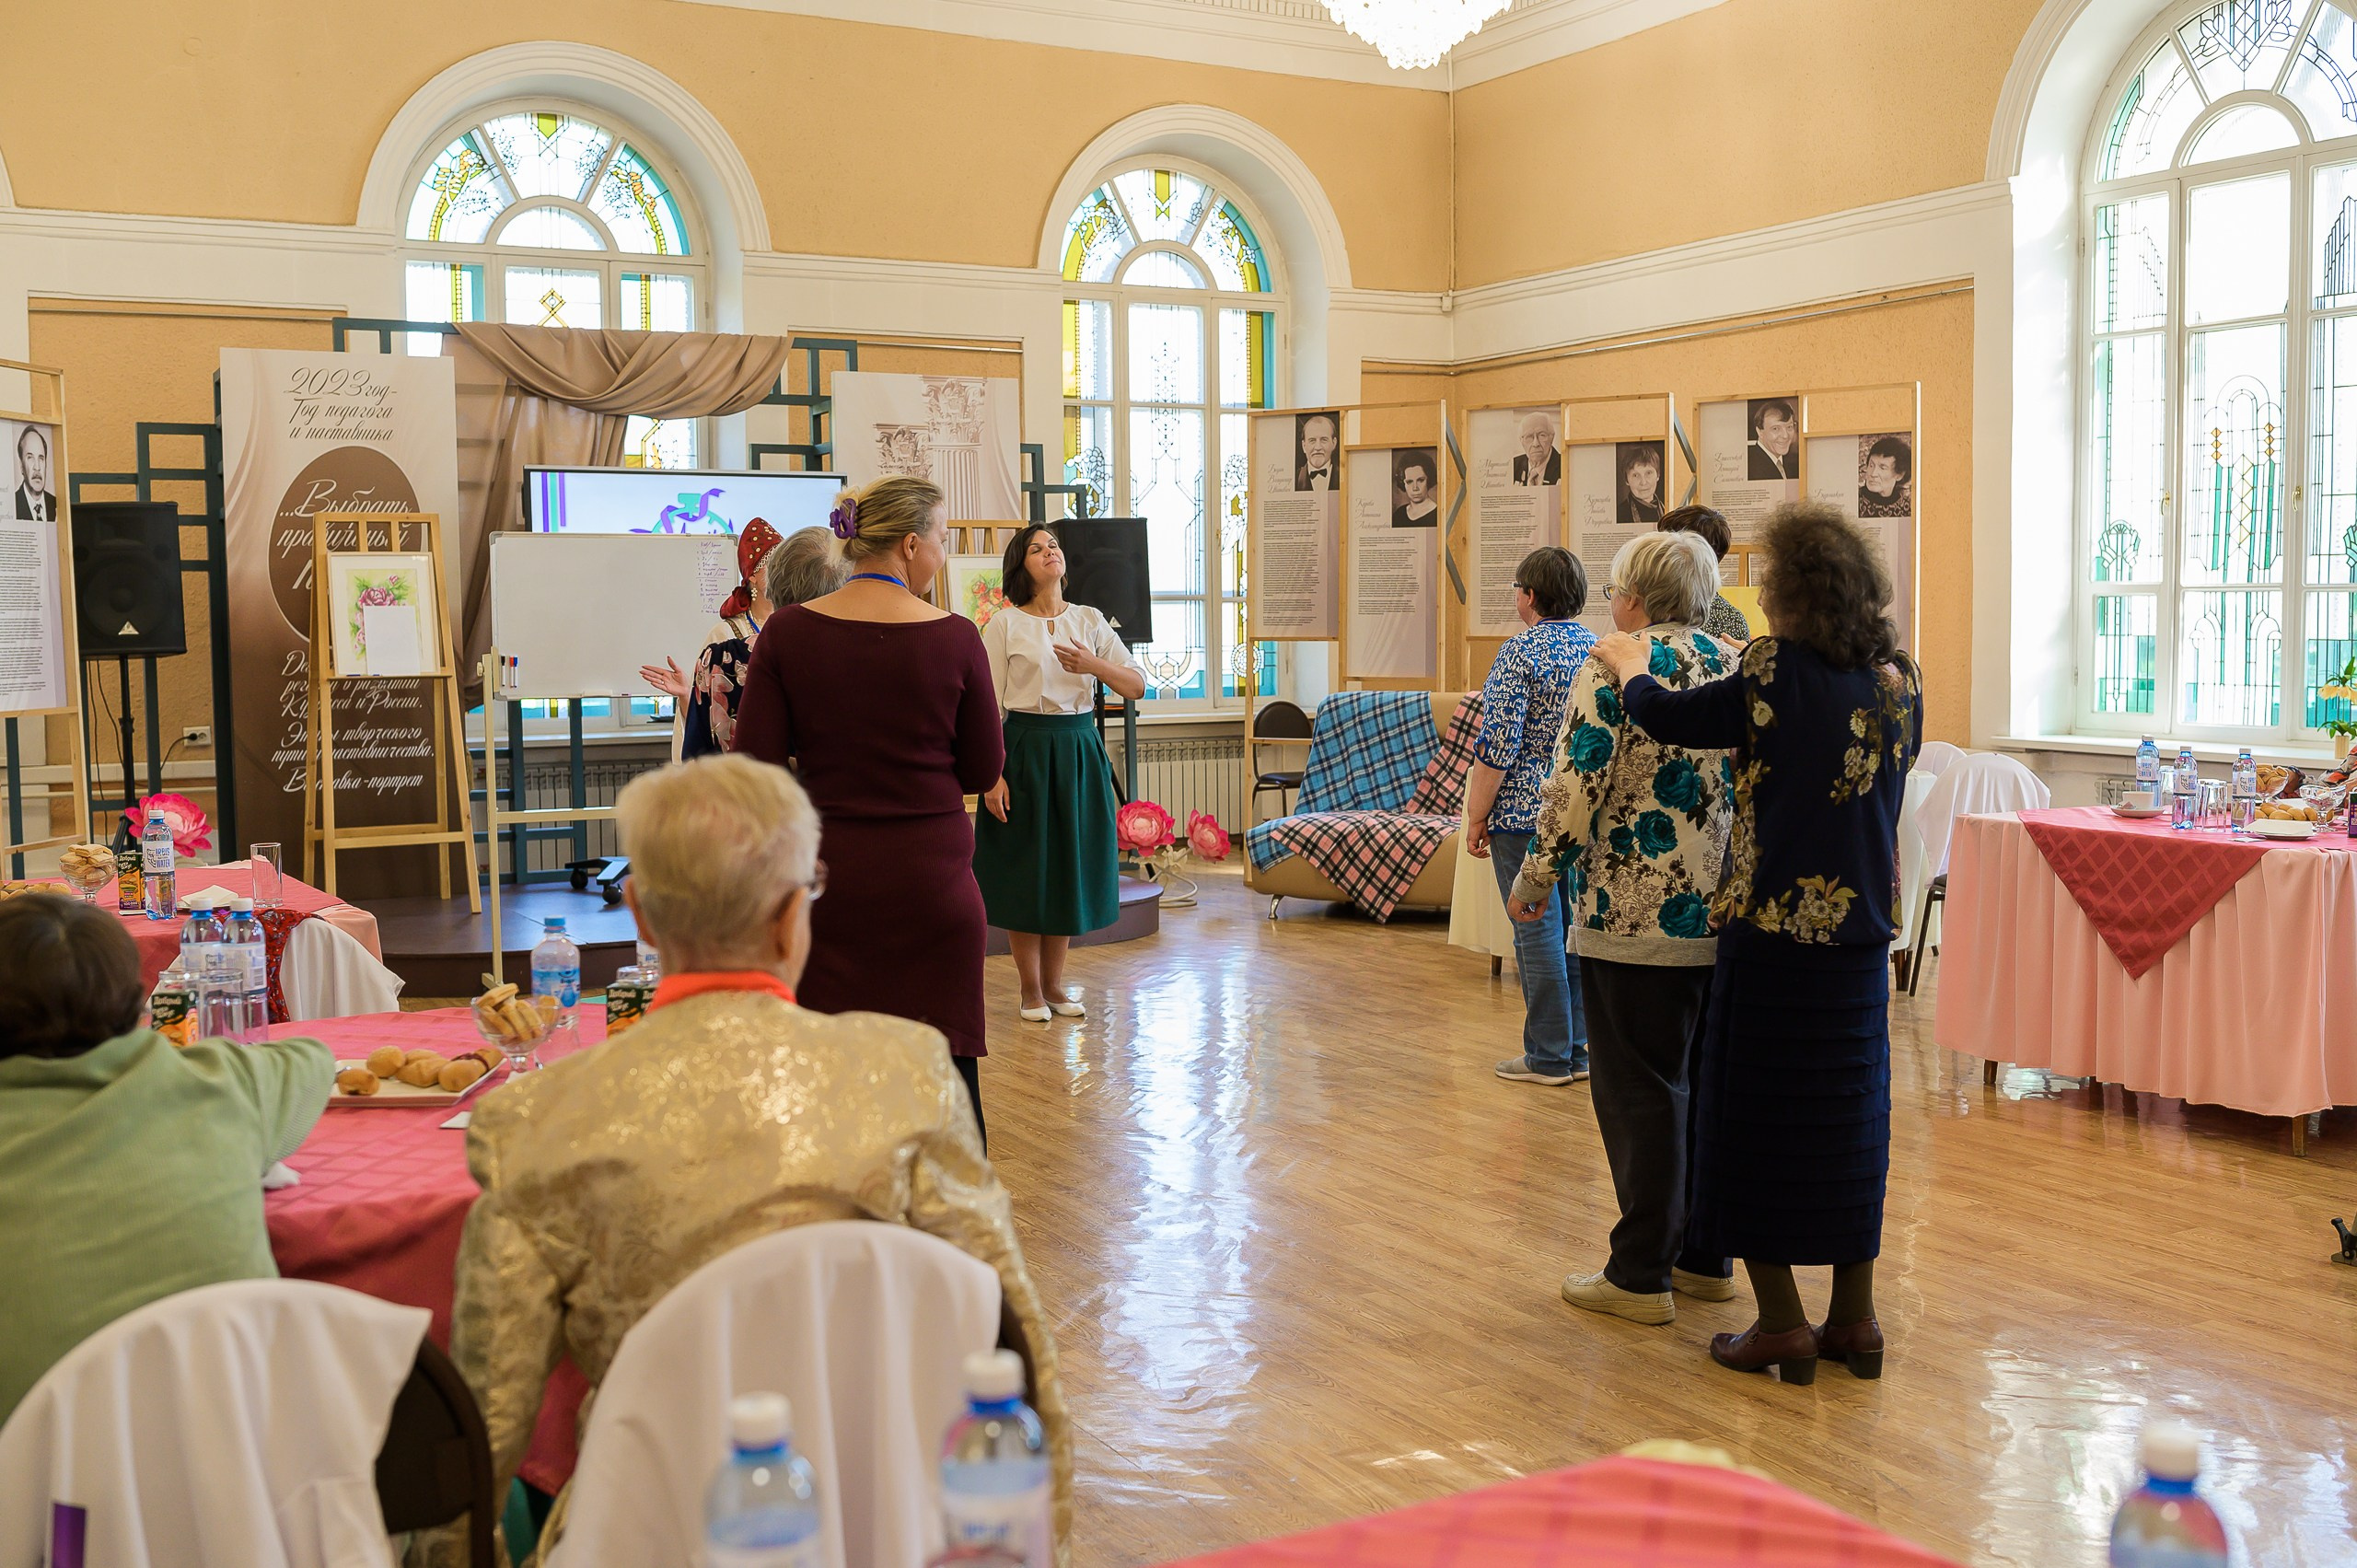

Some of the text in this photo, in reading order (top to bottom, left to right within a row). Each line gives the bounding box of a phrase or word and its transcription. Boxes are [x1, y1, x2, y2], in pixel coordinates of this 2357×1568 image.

[288, 397, 394, 426] Год педагога
[289, 420, 394, 441] и наставника
[354, 696, 367, 710] и
[366, 690, 424, 714] России.
[343, 721, 423, 748] творческого
[157, 859, 170, 867] WATER
